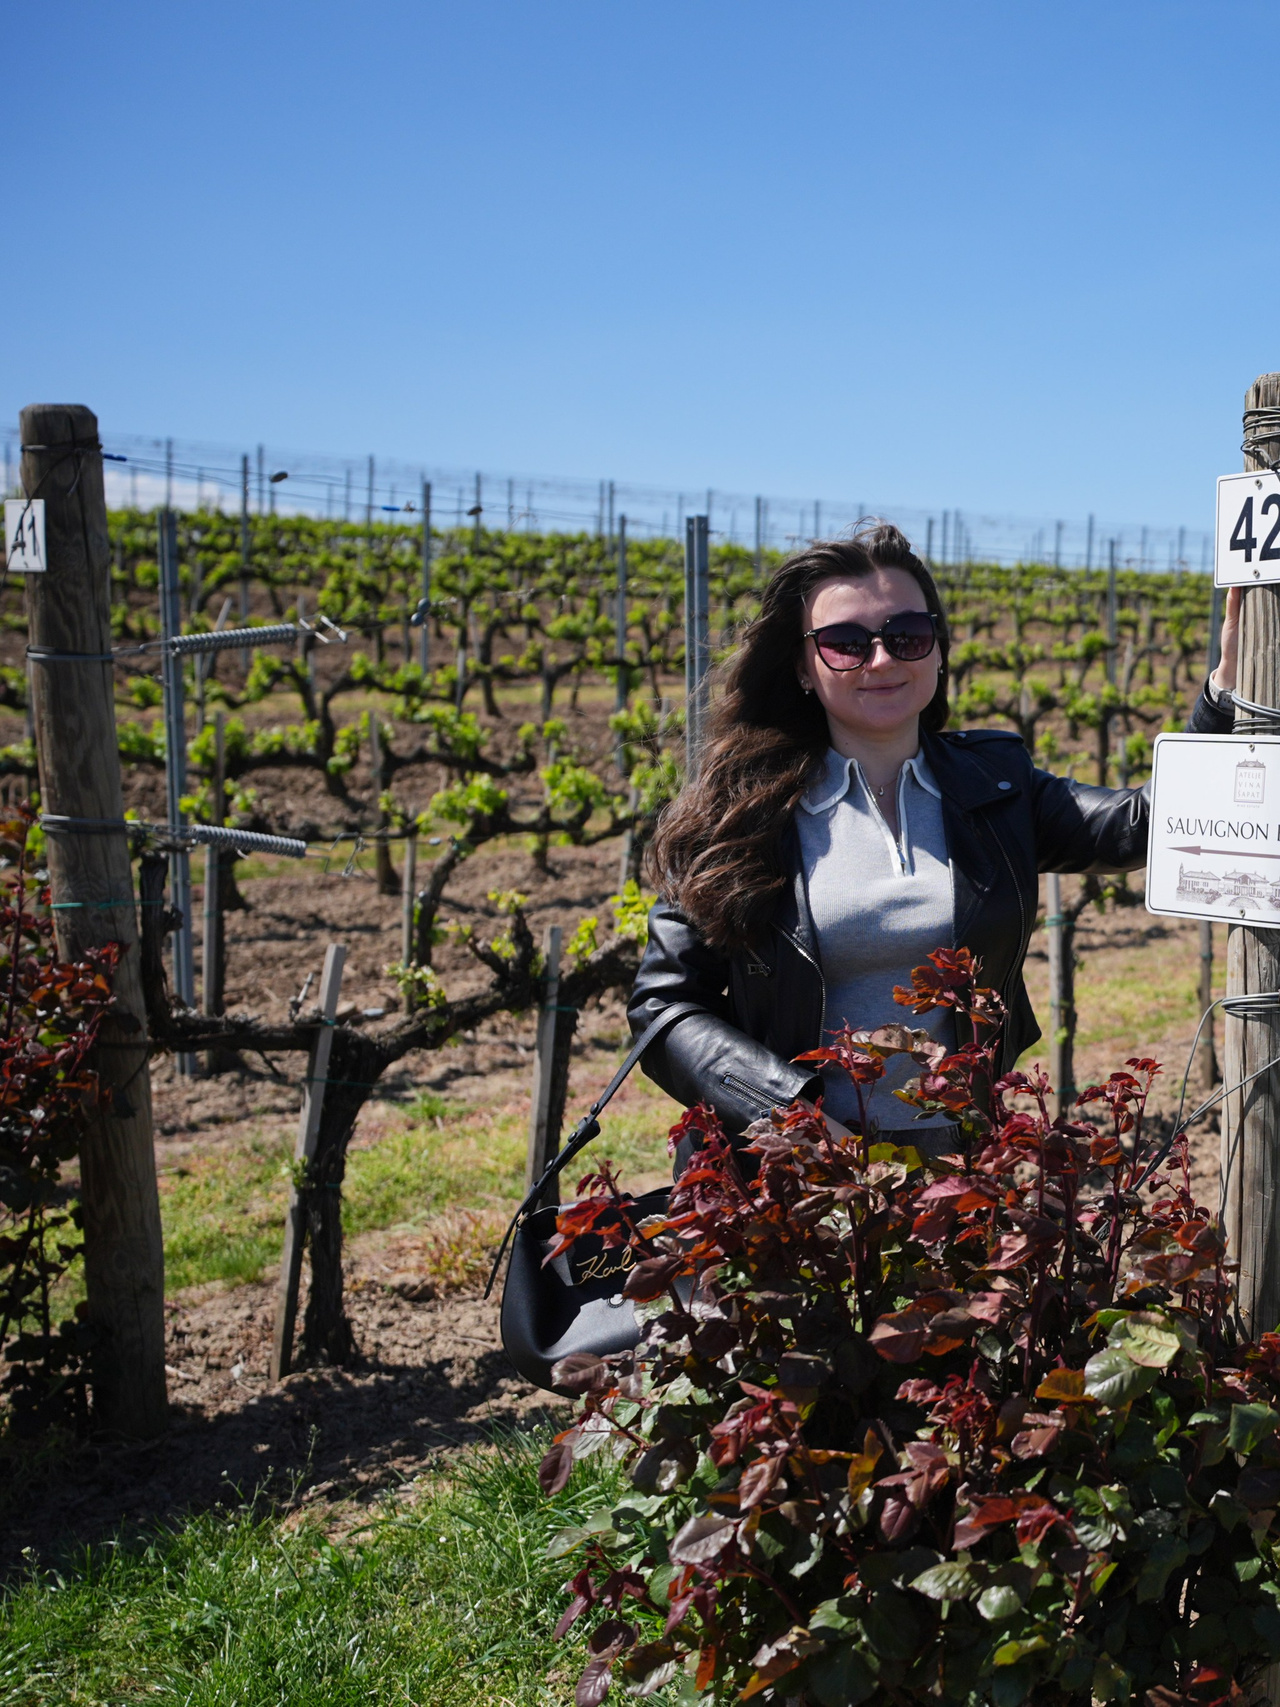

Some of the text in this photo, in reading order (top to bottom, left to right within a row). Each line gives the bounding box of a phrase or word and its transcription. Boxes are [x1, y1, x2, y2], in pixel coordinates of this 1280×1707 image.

[12, 514, 36, 556] 41
[1238, 781, 1261, 789] VINA
[1166, 816, 1270, 841] SAUVIGNON
